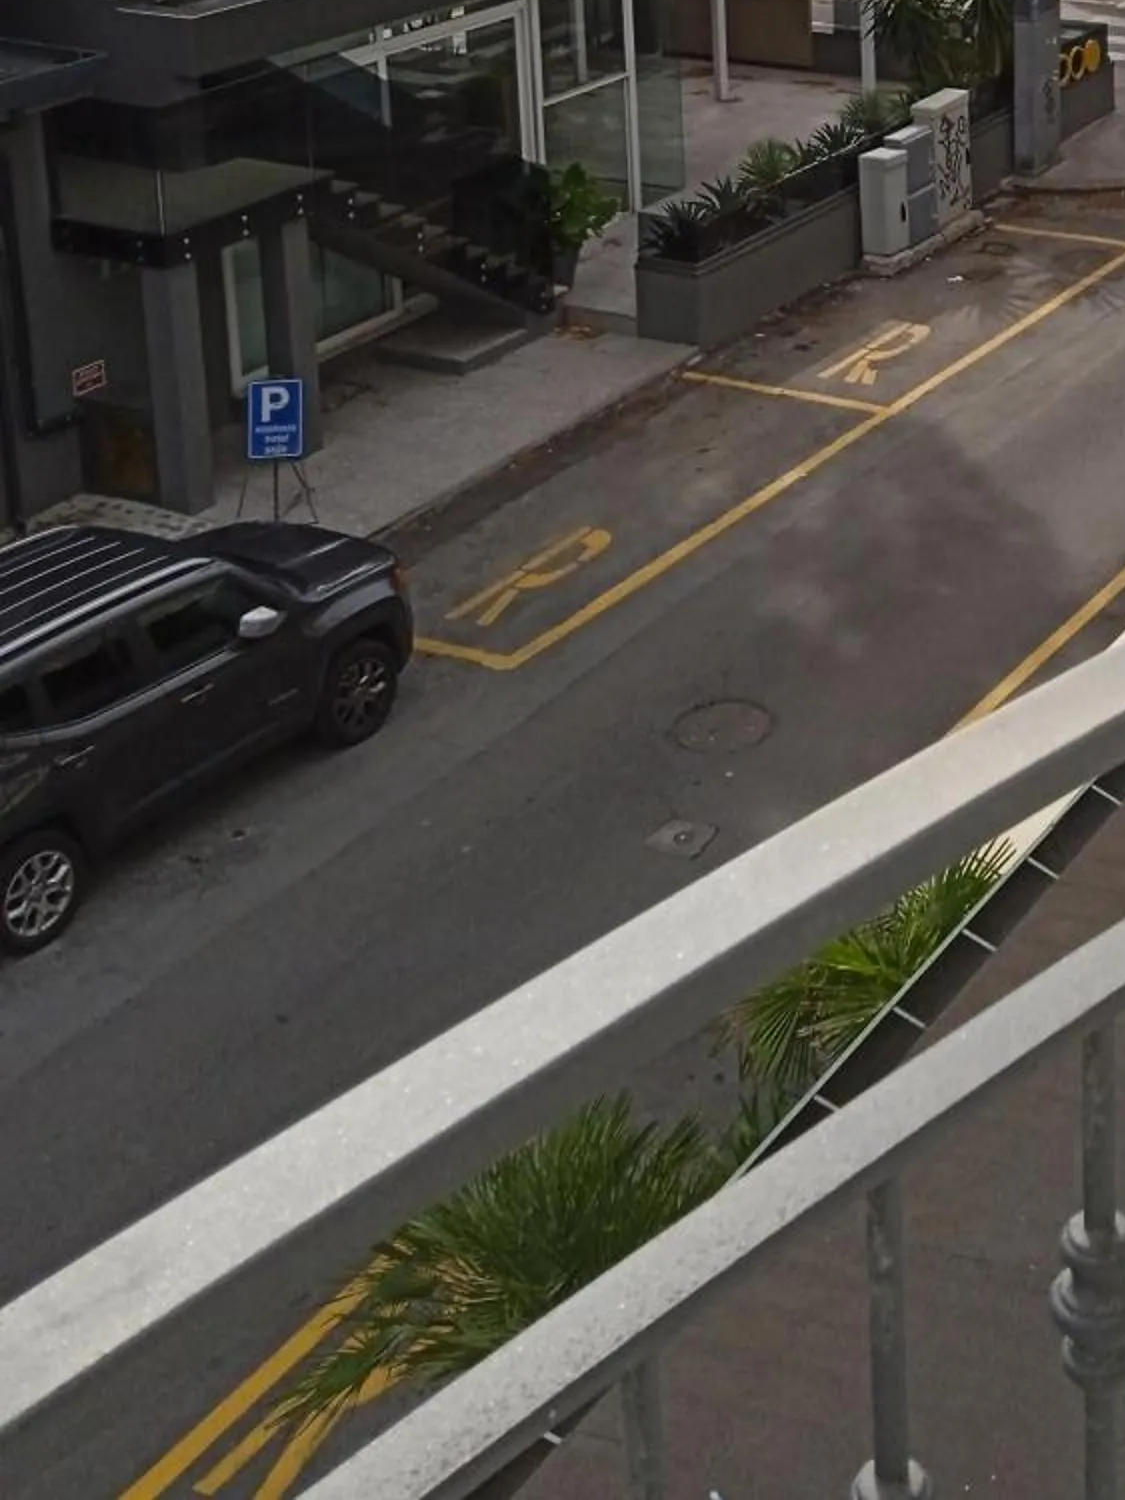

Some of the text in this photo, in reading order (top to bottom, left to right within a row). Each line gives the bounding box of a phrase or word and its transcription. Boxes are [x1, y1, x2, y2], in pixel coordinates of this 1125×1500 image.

[817, 320, 932, 386] R
[261, 386, 291, 423] P
[445, 525, 612, 626] R
